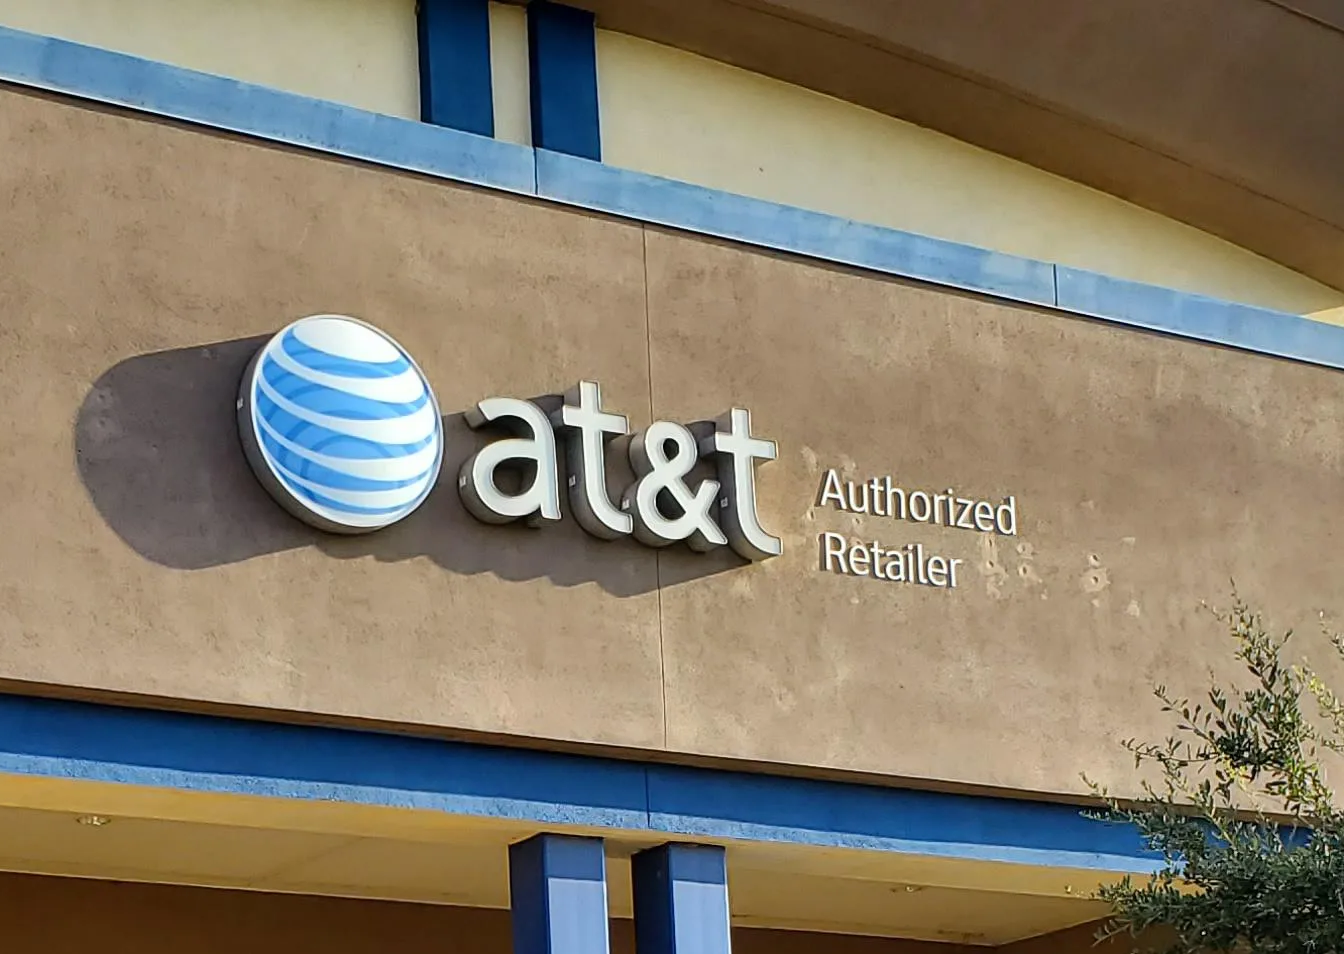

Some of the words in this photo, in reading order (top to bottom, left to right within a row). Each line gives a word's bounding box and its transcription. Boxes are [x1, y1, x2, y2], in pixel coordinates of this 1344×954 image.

[462, 379, 783, 560] at&t
[821, 468, 1017, 536] Authorized
[823, 531, 963, 588] Retailer
